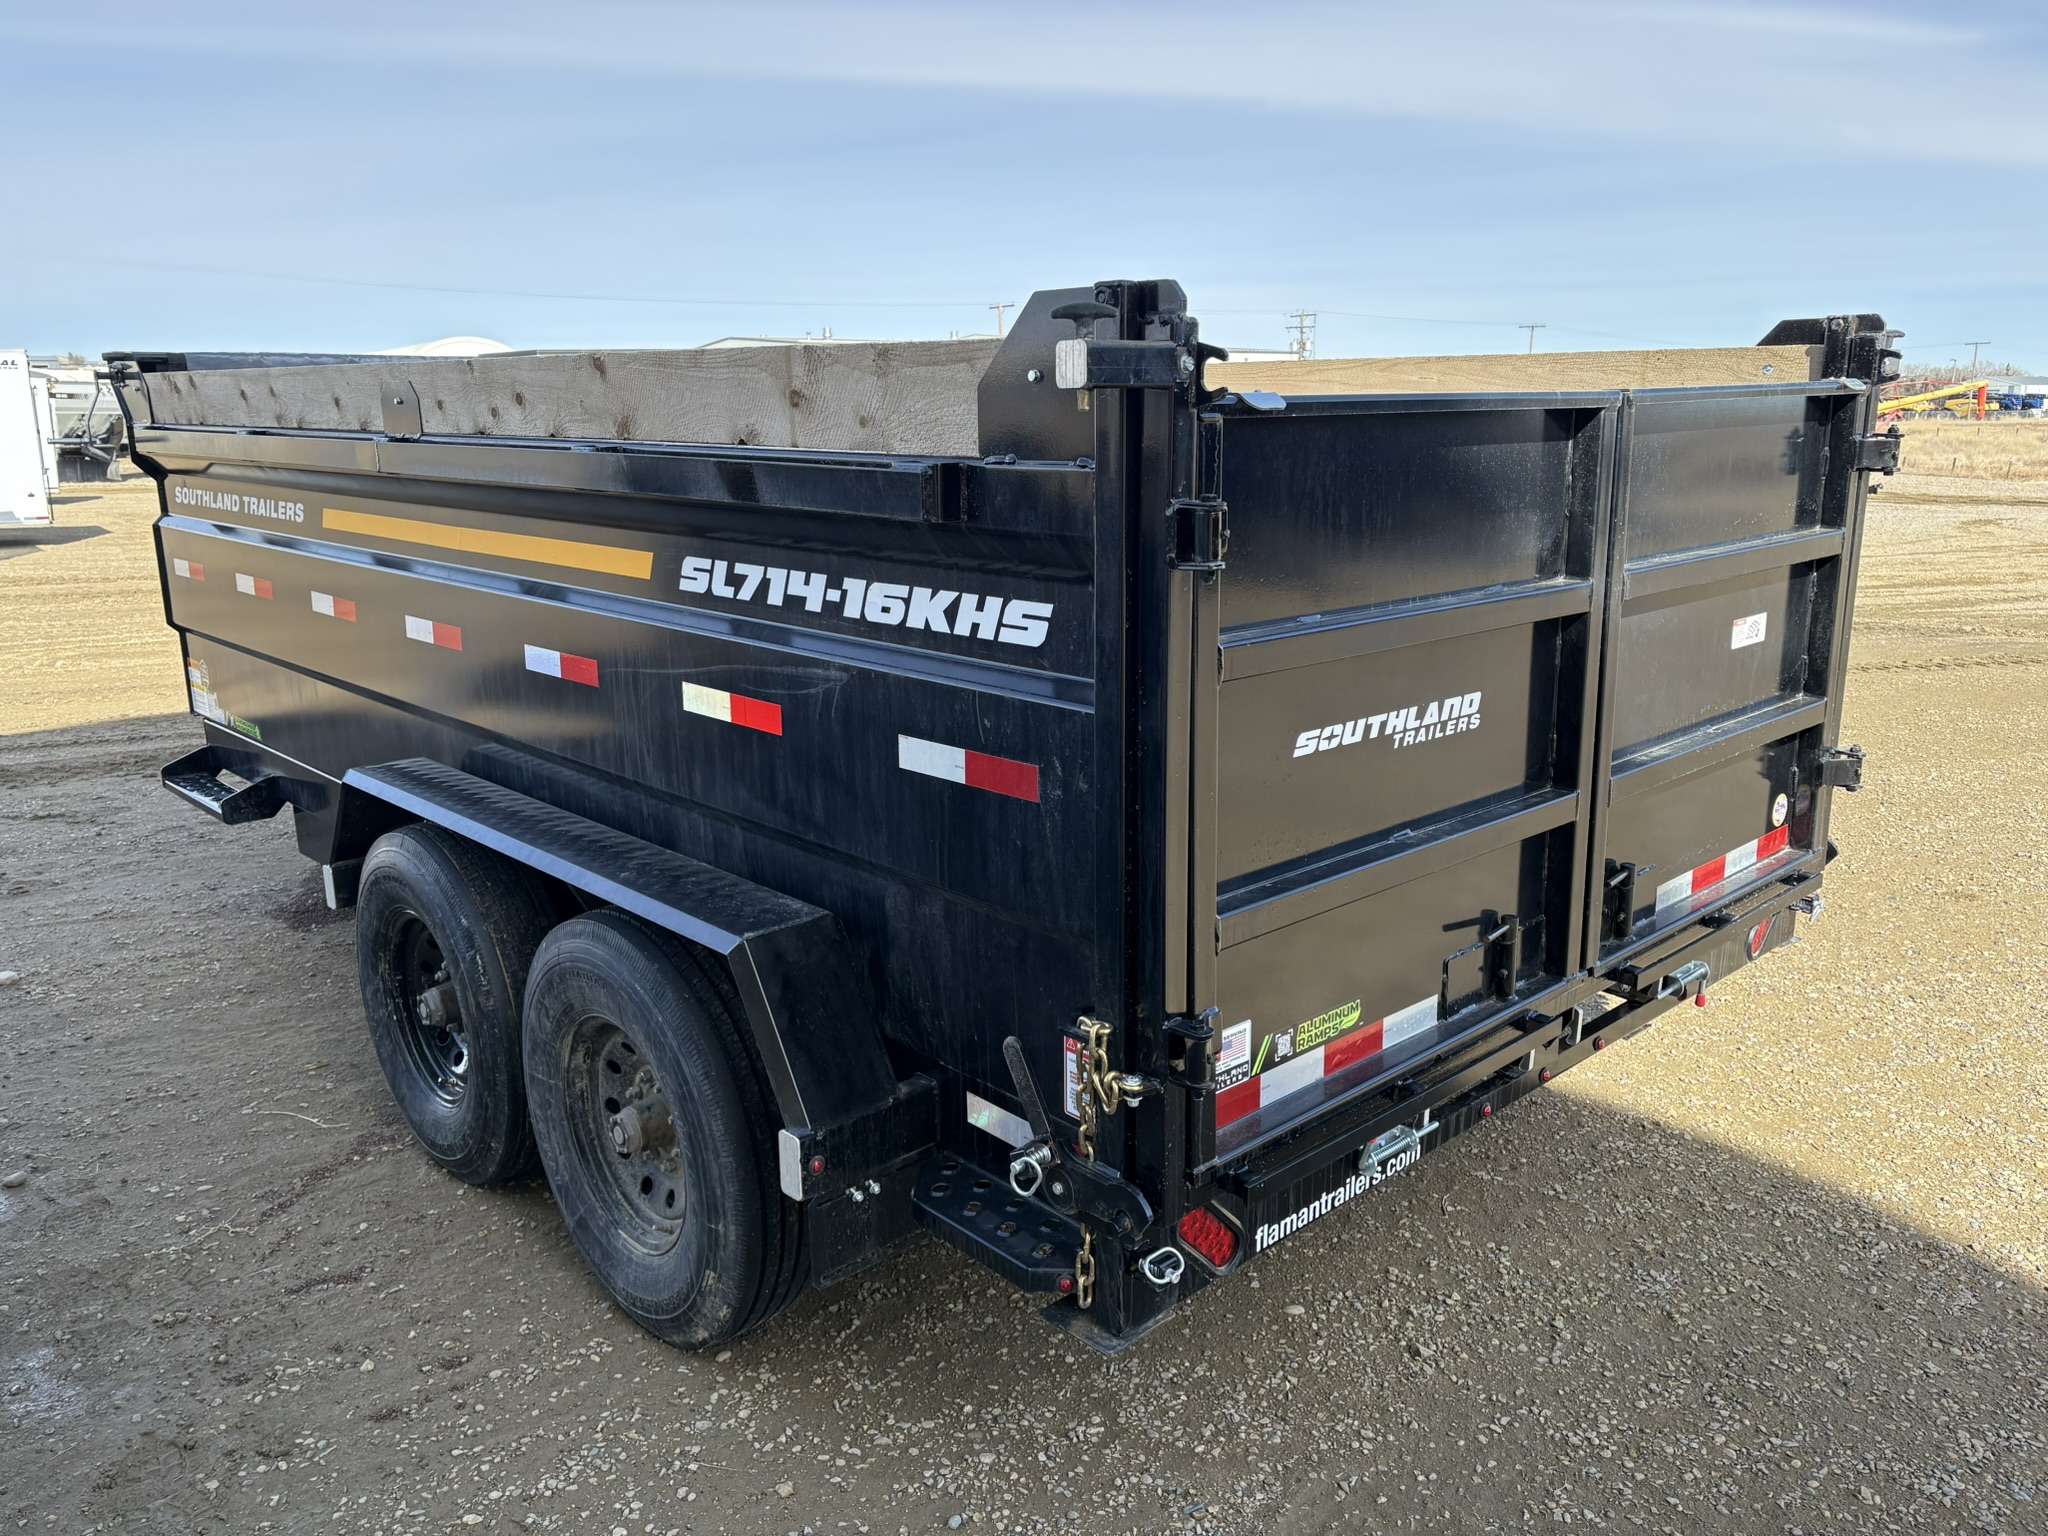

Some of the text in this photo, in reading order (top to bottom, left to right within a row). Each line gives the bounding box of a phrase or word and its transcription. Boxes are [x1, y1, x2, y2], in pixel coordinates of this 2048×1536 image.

[175, 486, 304, 523] SOUTHLAND TRAILERS
[679, 555, 1054, 648] SL714-16KHS
[1293, 691, 1482, 758] SOUTHLAND
[1393, 713, 1481, 749] TRAILERS
[1296, 1020, 1340, 1051] RAMPS
[1297, 1000, 1360, 1038] ALUMINUM
